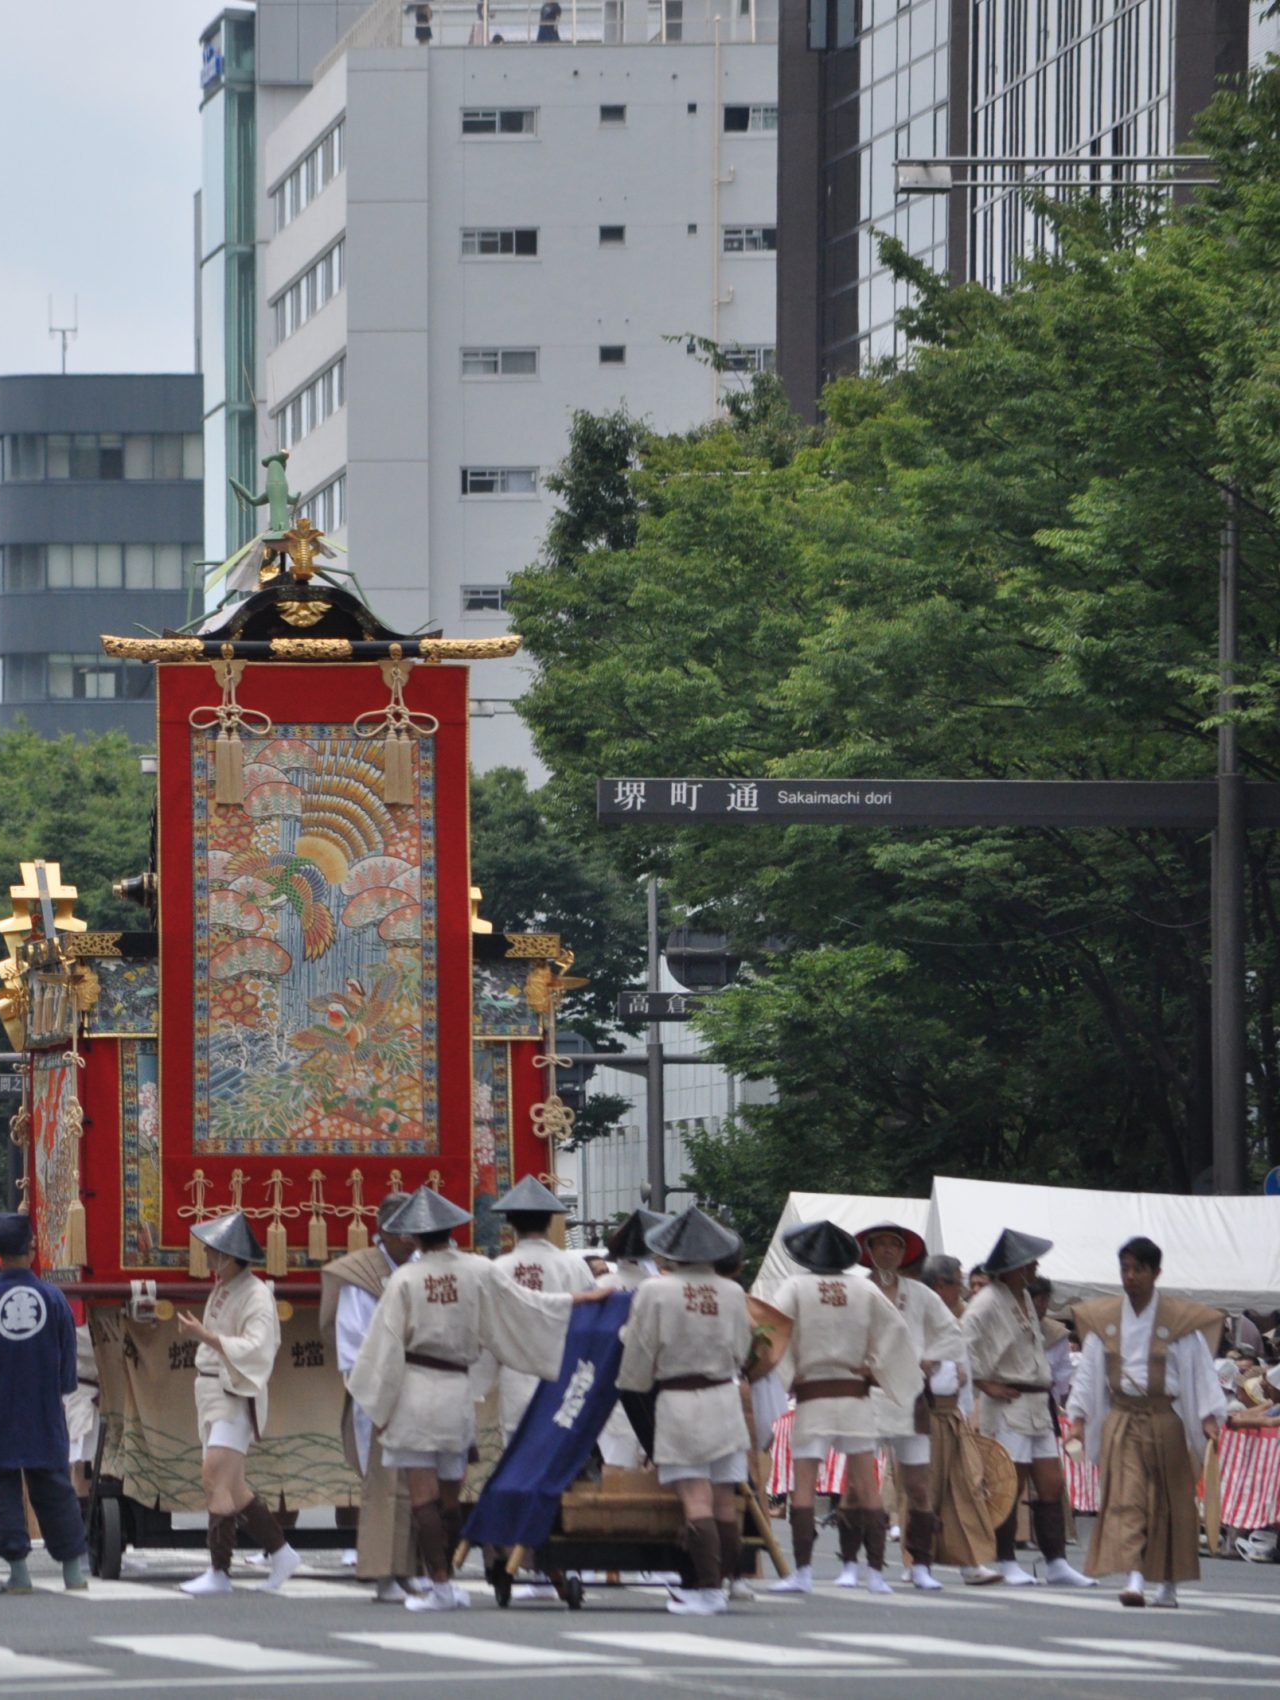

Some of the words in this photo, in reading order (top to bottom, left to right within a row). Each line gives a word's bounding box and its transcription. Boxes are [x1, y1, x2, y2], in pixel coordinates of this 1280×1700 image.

[614, 782, 759, 812] 堺町通
[777, 790, 860, 805] Sakaimachi
[864, 791, 892, 805] dori
